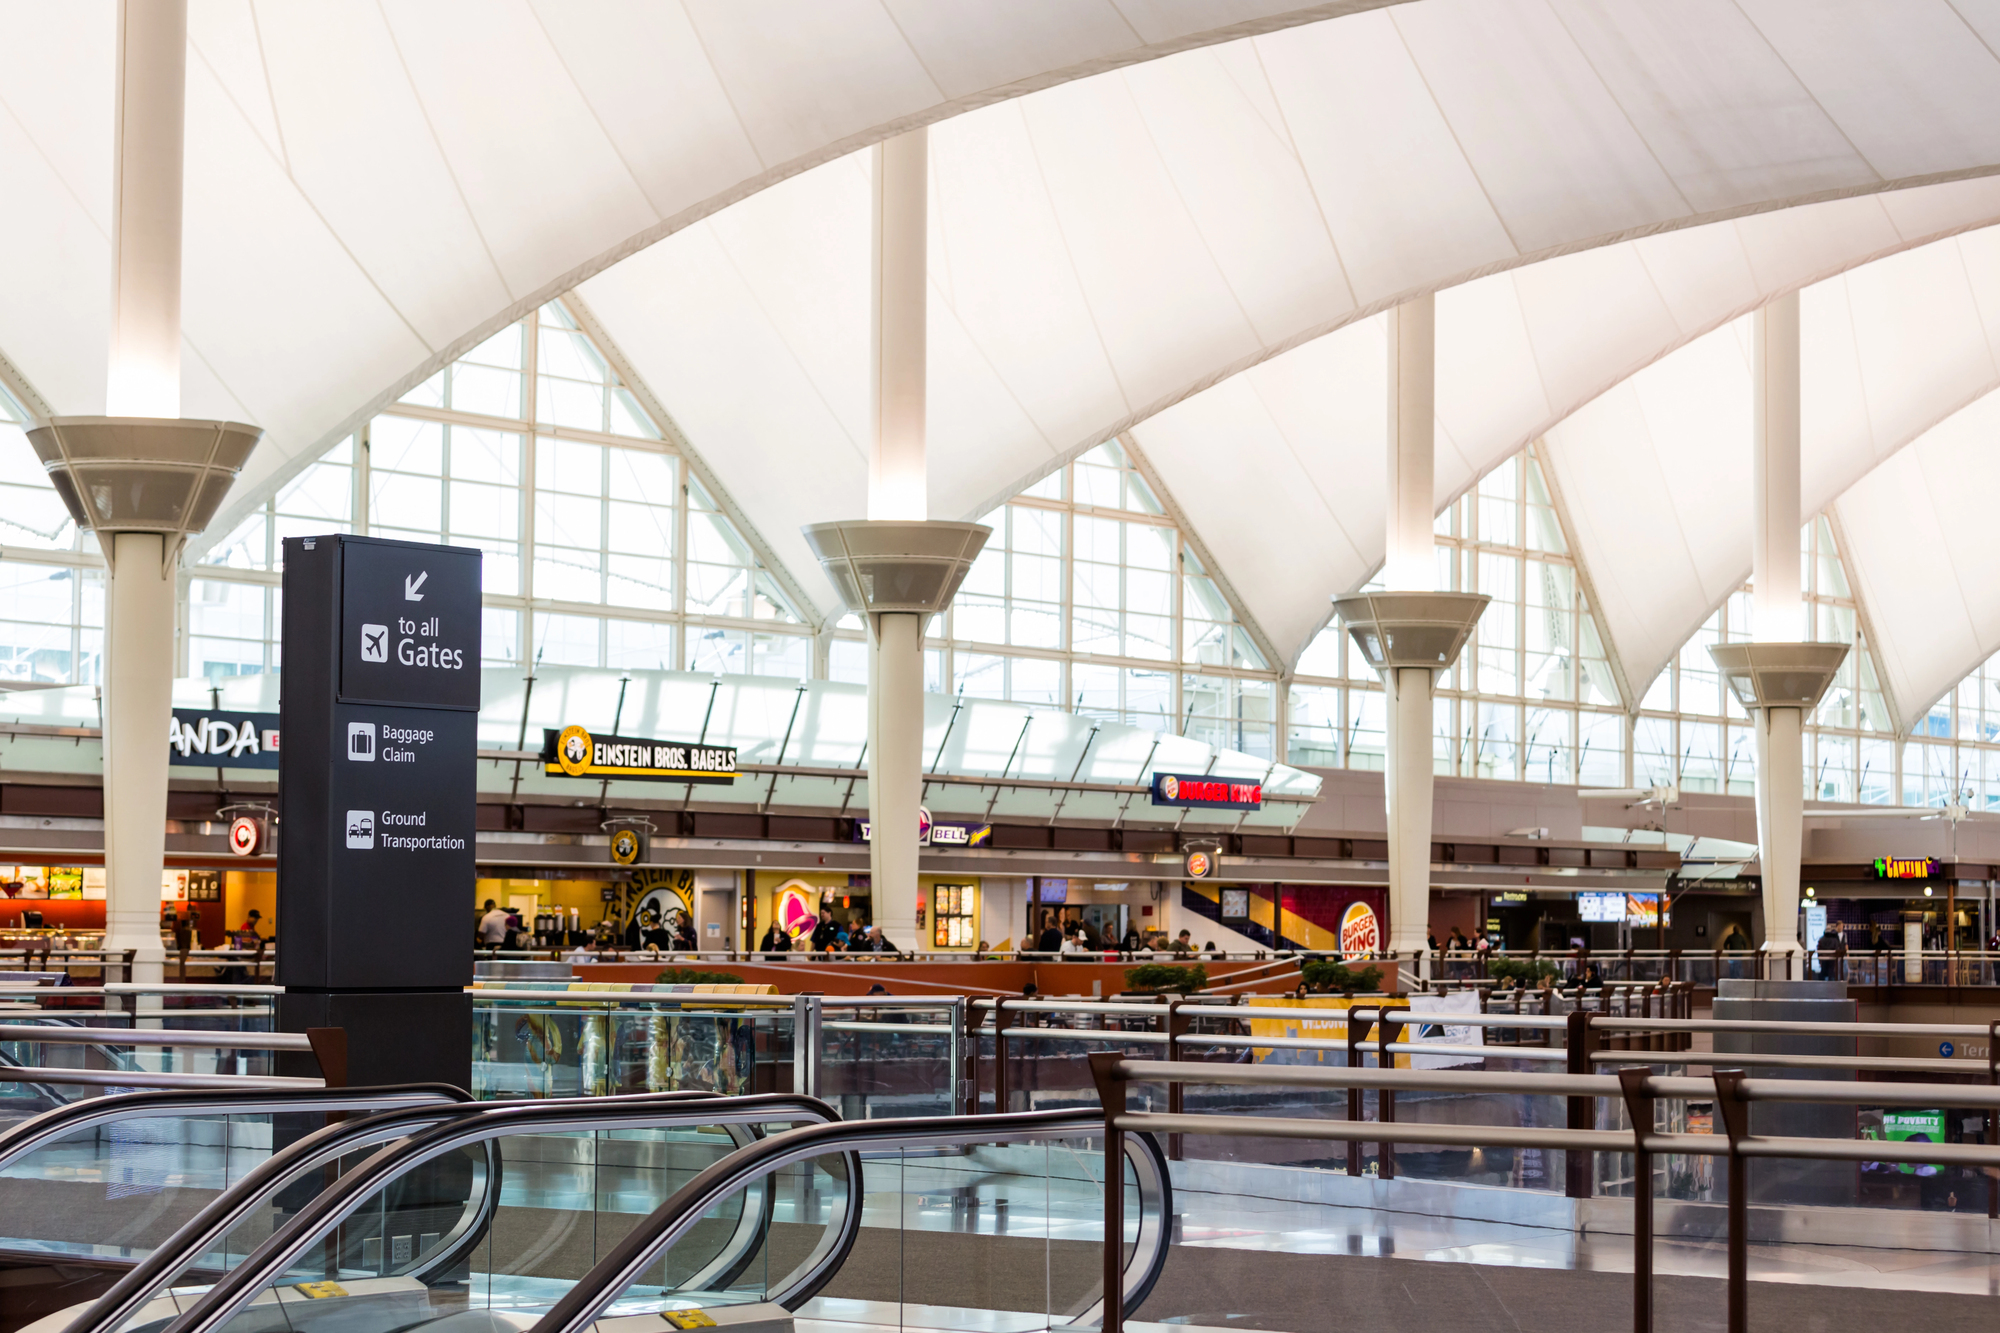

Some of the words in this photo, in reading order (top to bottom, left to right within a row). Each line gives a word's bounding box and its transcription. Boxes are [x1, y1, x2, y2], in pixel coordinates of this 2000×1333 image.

[398, 616, 415, 635] to
[420, 617, 439, 637] all
[397, 638, 463, 670] Gates
[169, 716, 259, 758] ANDA
[382, 725, 434, 744] Baggage
[382, 747, 415, 762] Claim
[594, 743, 652, 767] EINSTEIN
[654, 747, 688, 769] BROS.
[690, 749, 737, 772] BAGELS
[1178, 781, 1229, 802] BURGER
[1230, 784, 1262, 804] KING
[381, 811, 426, 826] Ground
[381, 833, 465, 852] Transportation
[934, 828, 967, 841] BELL
[1342, 914, 1374, 944] BURGER
[1344, 928, 1376, 960] KING
